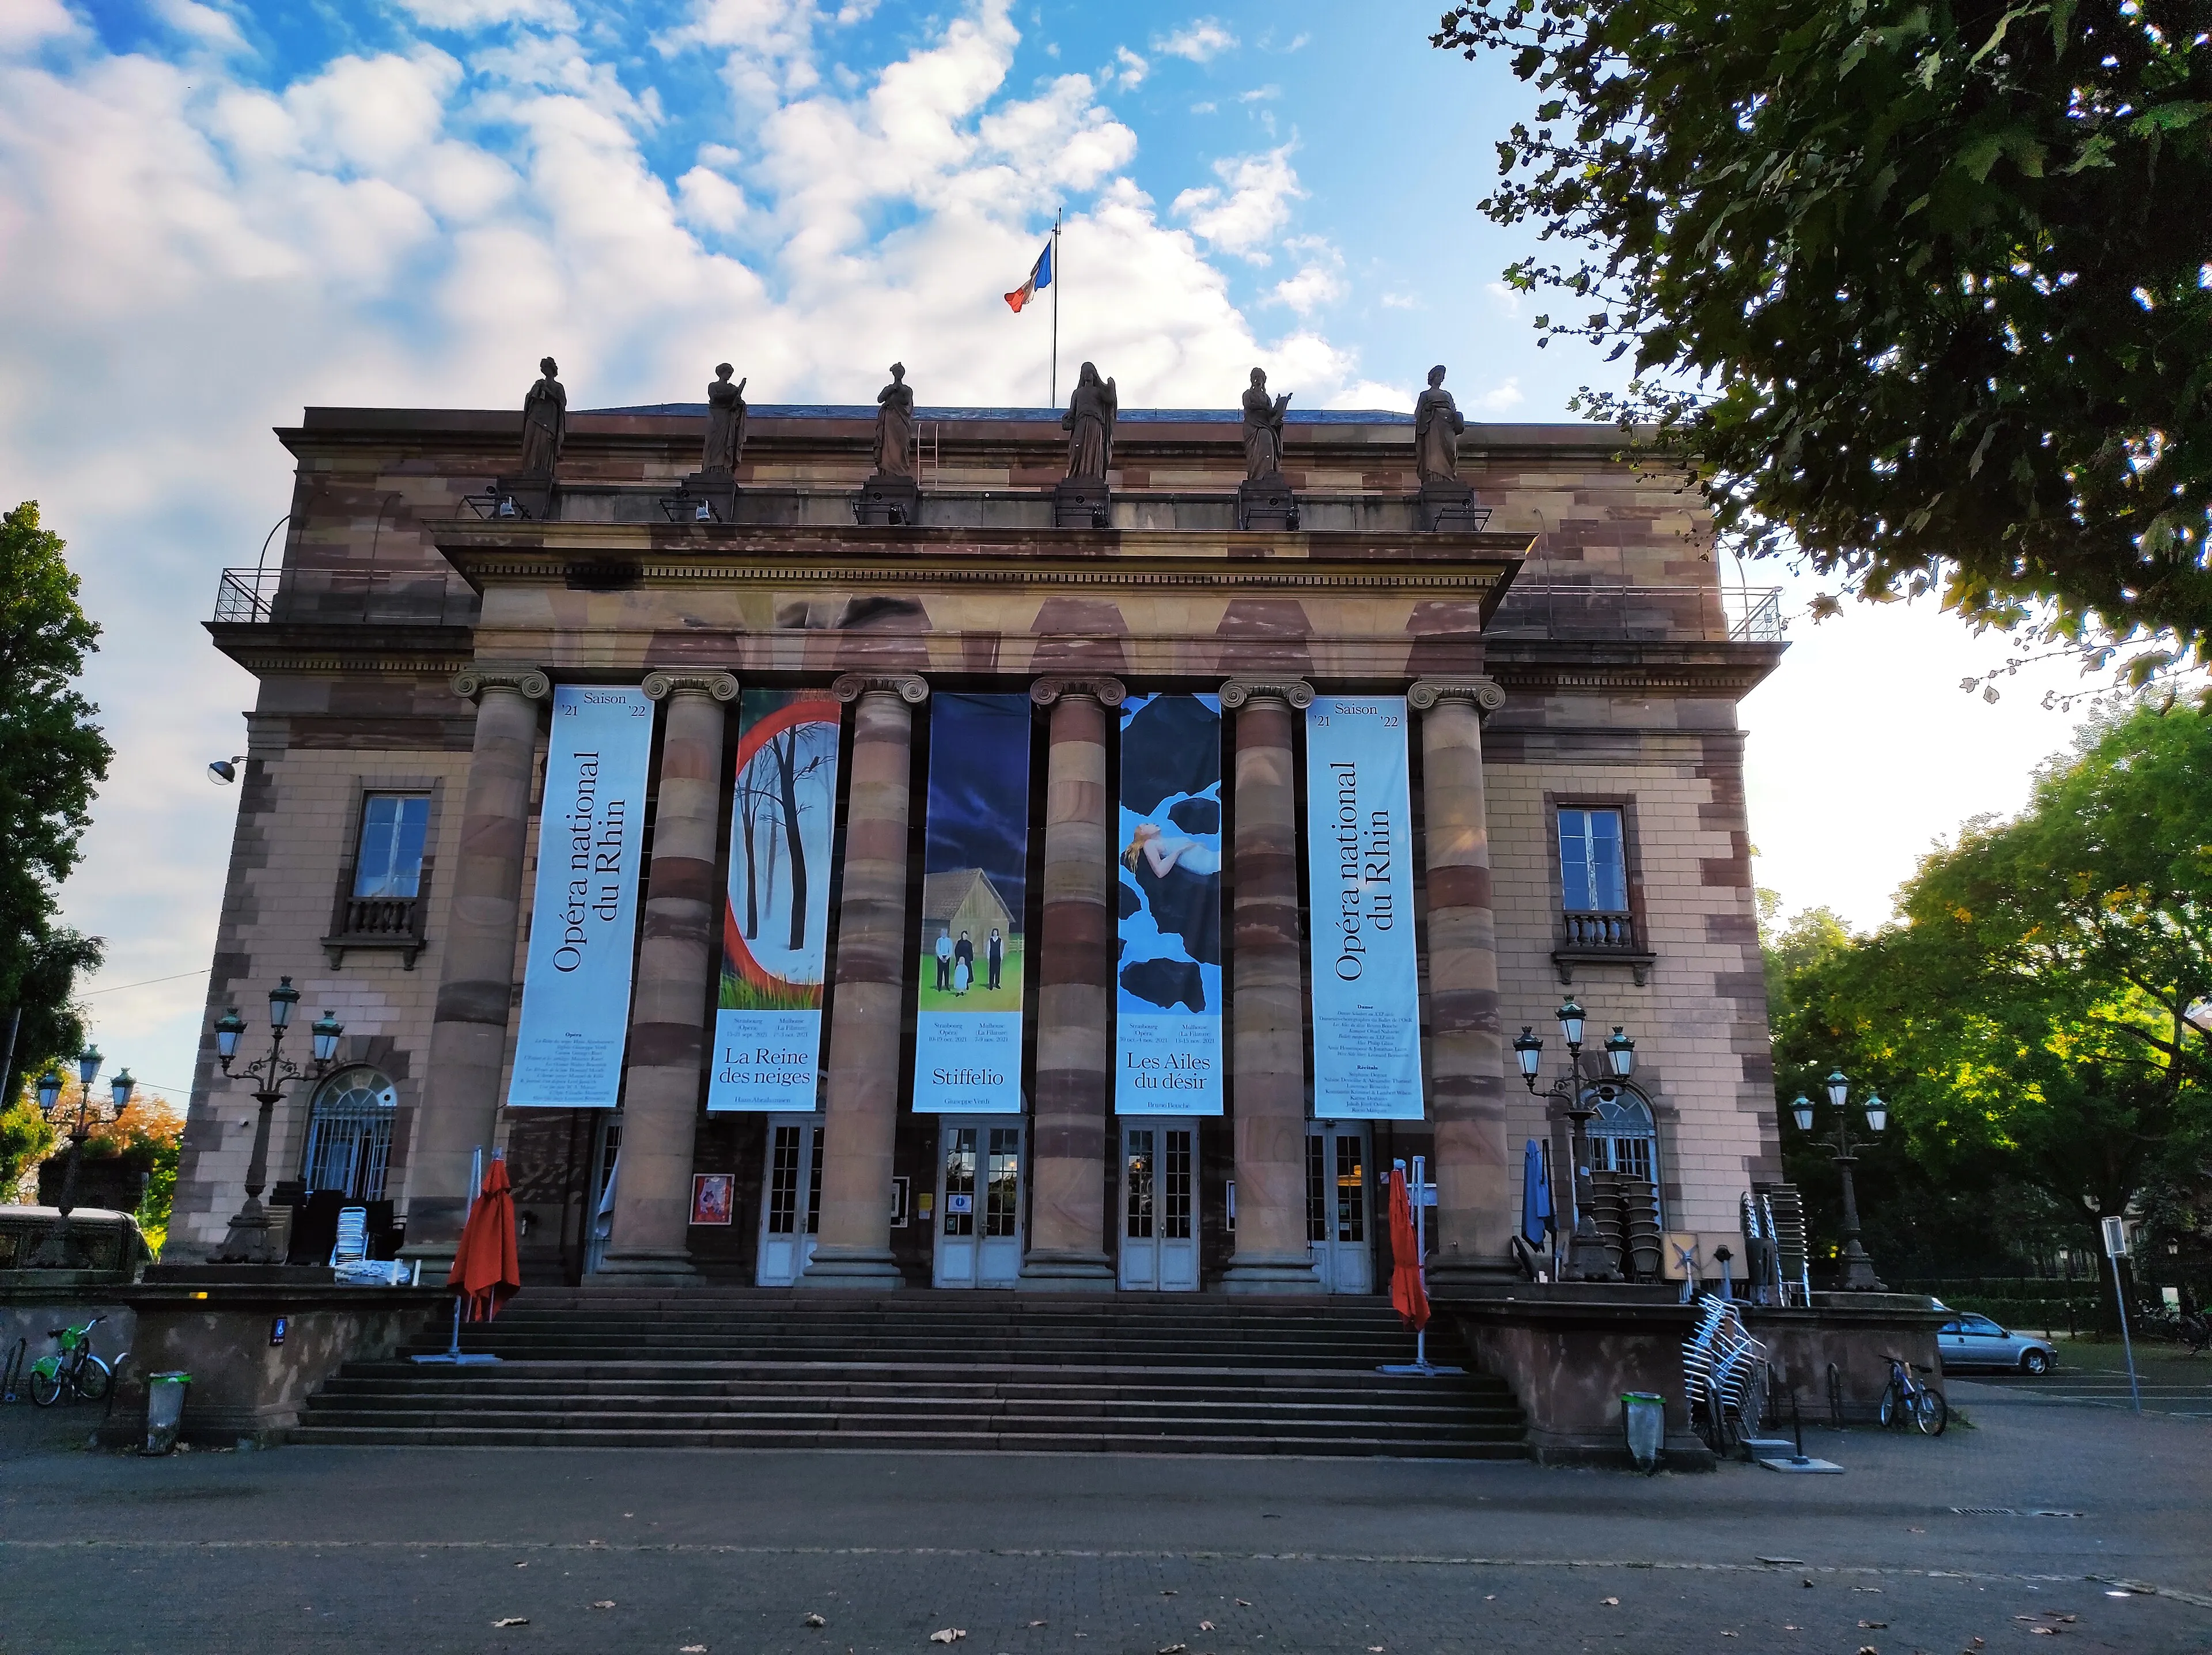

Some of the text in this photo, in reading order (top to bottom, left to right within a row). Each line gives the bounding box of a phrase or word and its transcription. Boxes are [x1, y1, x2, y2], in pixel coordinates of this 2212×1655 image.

[584, 692, 626, 704] Saison
[1335, 702, 1378, 715] Saison
[1330, 761, 1358, 880] national
[553, 751, 600, 972] Opéra national
[592, 799, 626, 922] du Rhin
[1363, 809, 1393, 931] du Rhin
[1335, 887, 1366, 981] Opéra
[724, 1047, 808, 1065] La Reine
[1127, 1052, 1210, 1070] Les Ailes
[719, 1067, 810, 1086] des neiges
[932, 1068, 1003, 1085] Stiffelio
[1135, 1072, 1207, 1089] du désir
